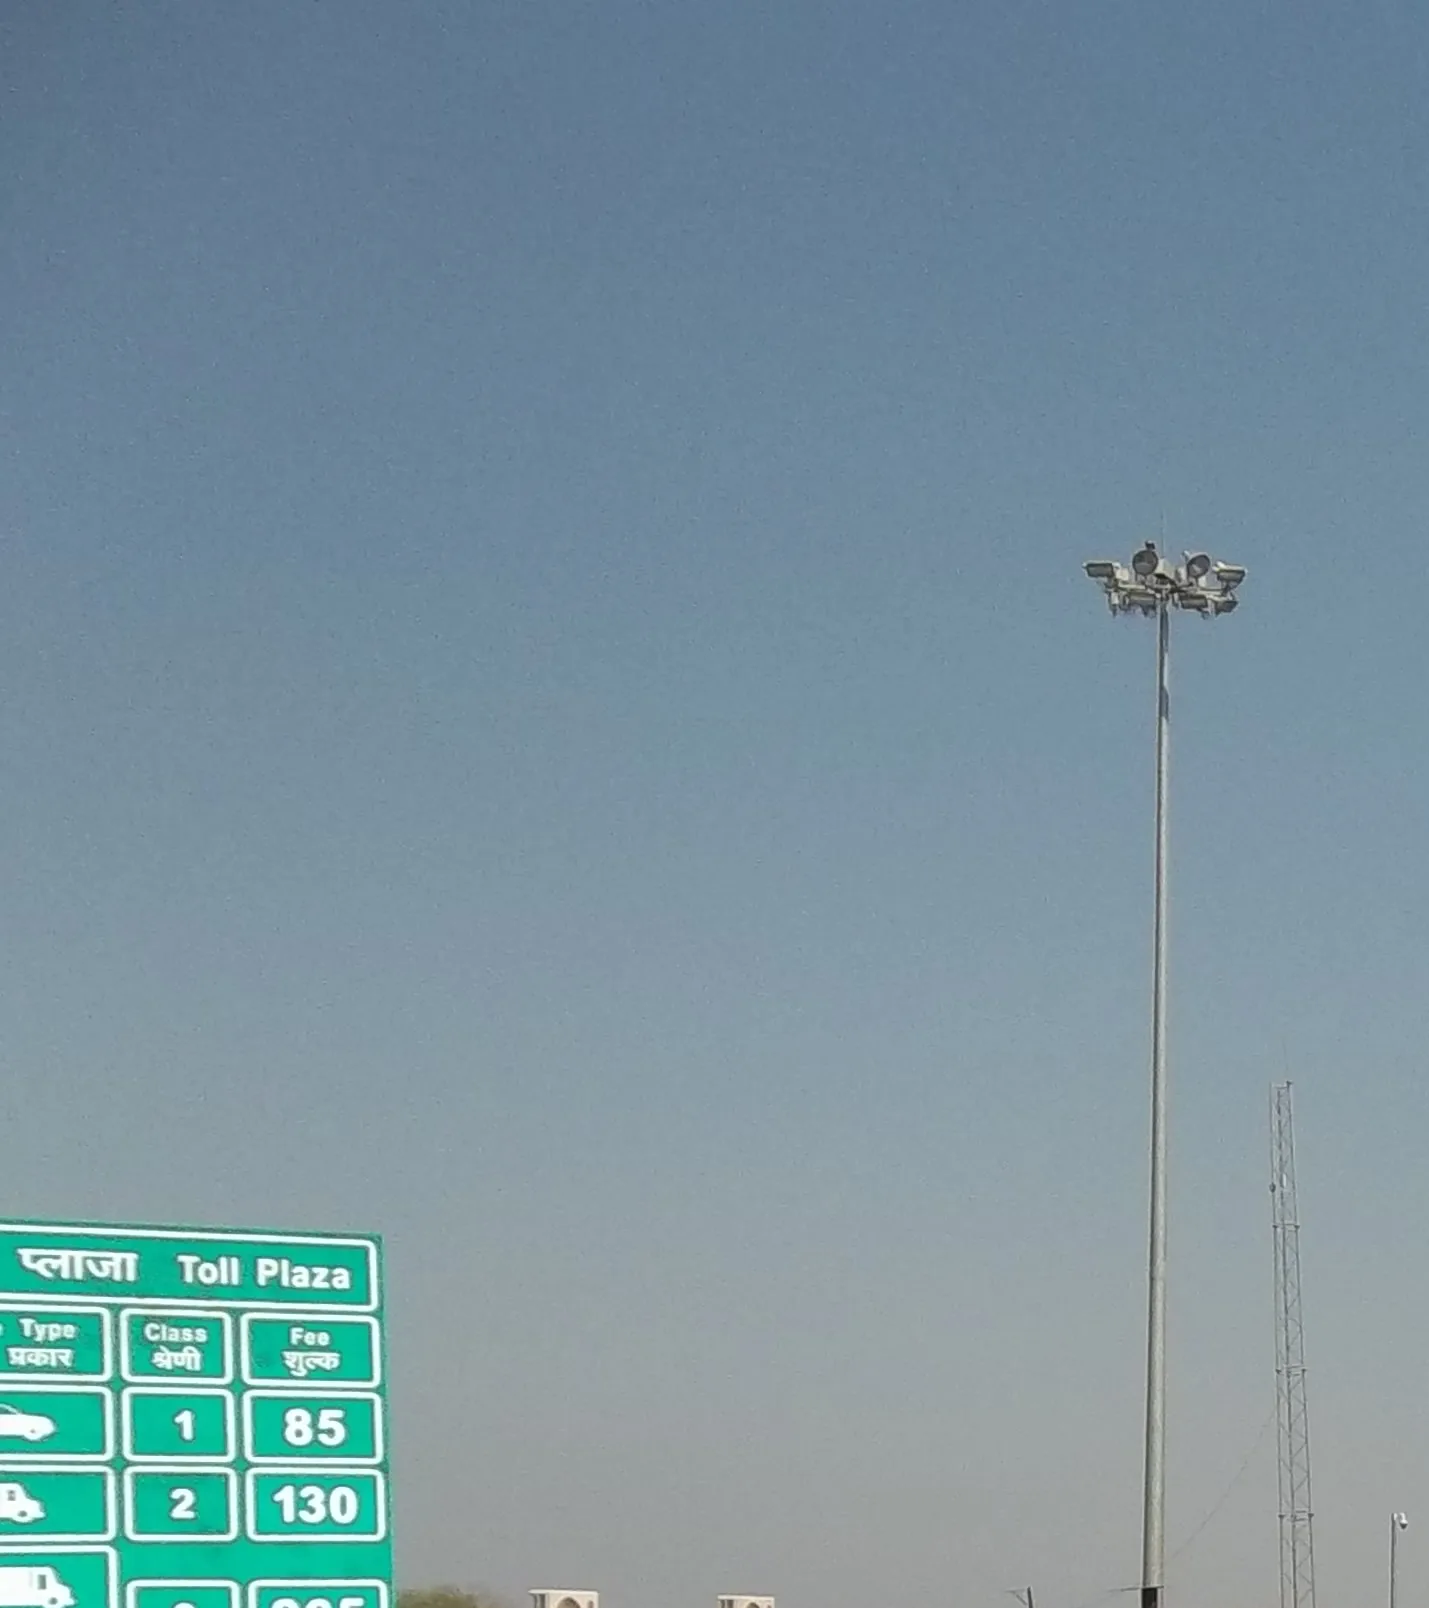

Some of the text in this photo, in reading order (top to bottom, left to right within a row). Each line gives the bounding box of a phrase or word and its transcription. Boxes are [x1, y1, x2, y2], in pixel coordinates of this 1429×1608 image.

[16, 1247, 139, 1282] प्लाजा
[176, 1254, 351, 1290] Toll Plaza
[19, 1317, 78, 1343] Type
[143, 1322, 208, 1344] Class
[290, 1326, 331, 1347] Fee
[6, 1346, 74, 1368] प्रकार
[150, 1345, 202, 1373] श्रेणी
[282, 1350, 341, 1377] शुल्क
[174, 1410, 195, 1441] 1
[283, 1407, 347, 1447] 85
[170, 1487, 197, 1520] 2
[272, 1484, 359, 1525] 130
